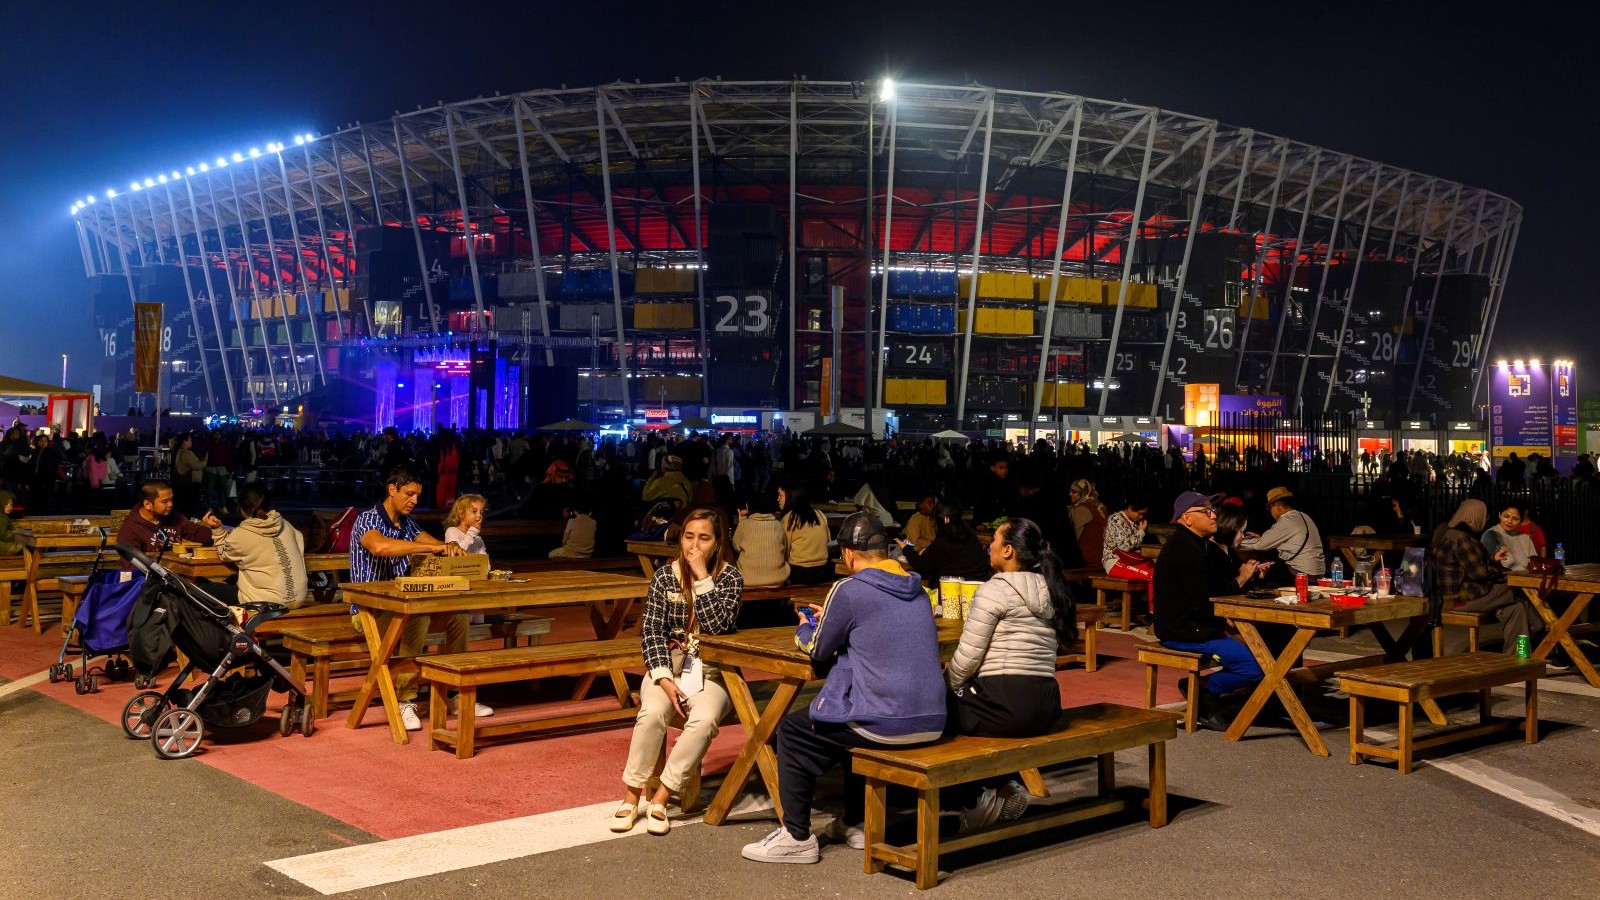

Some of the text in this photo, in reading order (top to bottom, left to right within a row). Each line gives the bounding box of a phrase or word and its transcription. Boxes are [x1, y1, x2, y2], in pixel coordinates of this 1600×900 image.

[715, 295, 768, 332] 23
[103, 332, 117, 357] 16
[1205, 315, 1233, 350] 26
[905, 345, 932, 364] 24
[1371, 332, 1393, 361] 28
[1452, 340, 1471, 368] 29
[1116, 353, 1134, 371] 25
[1256, 398, 1282, 408] القهوة
